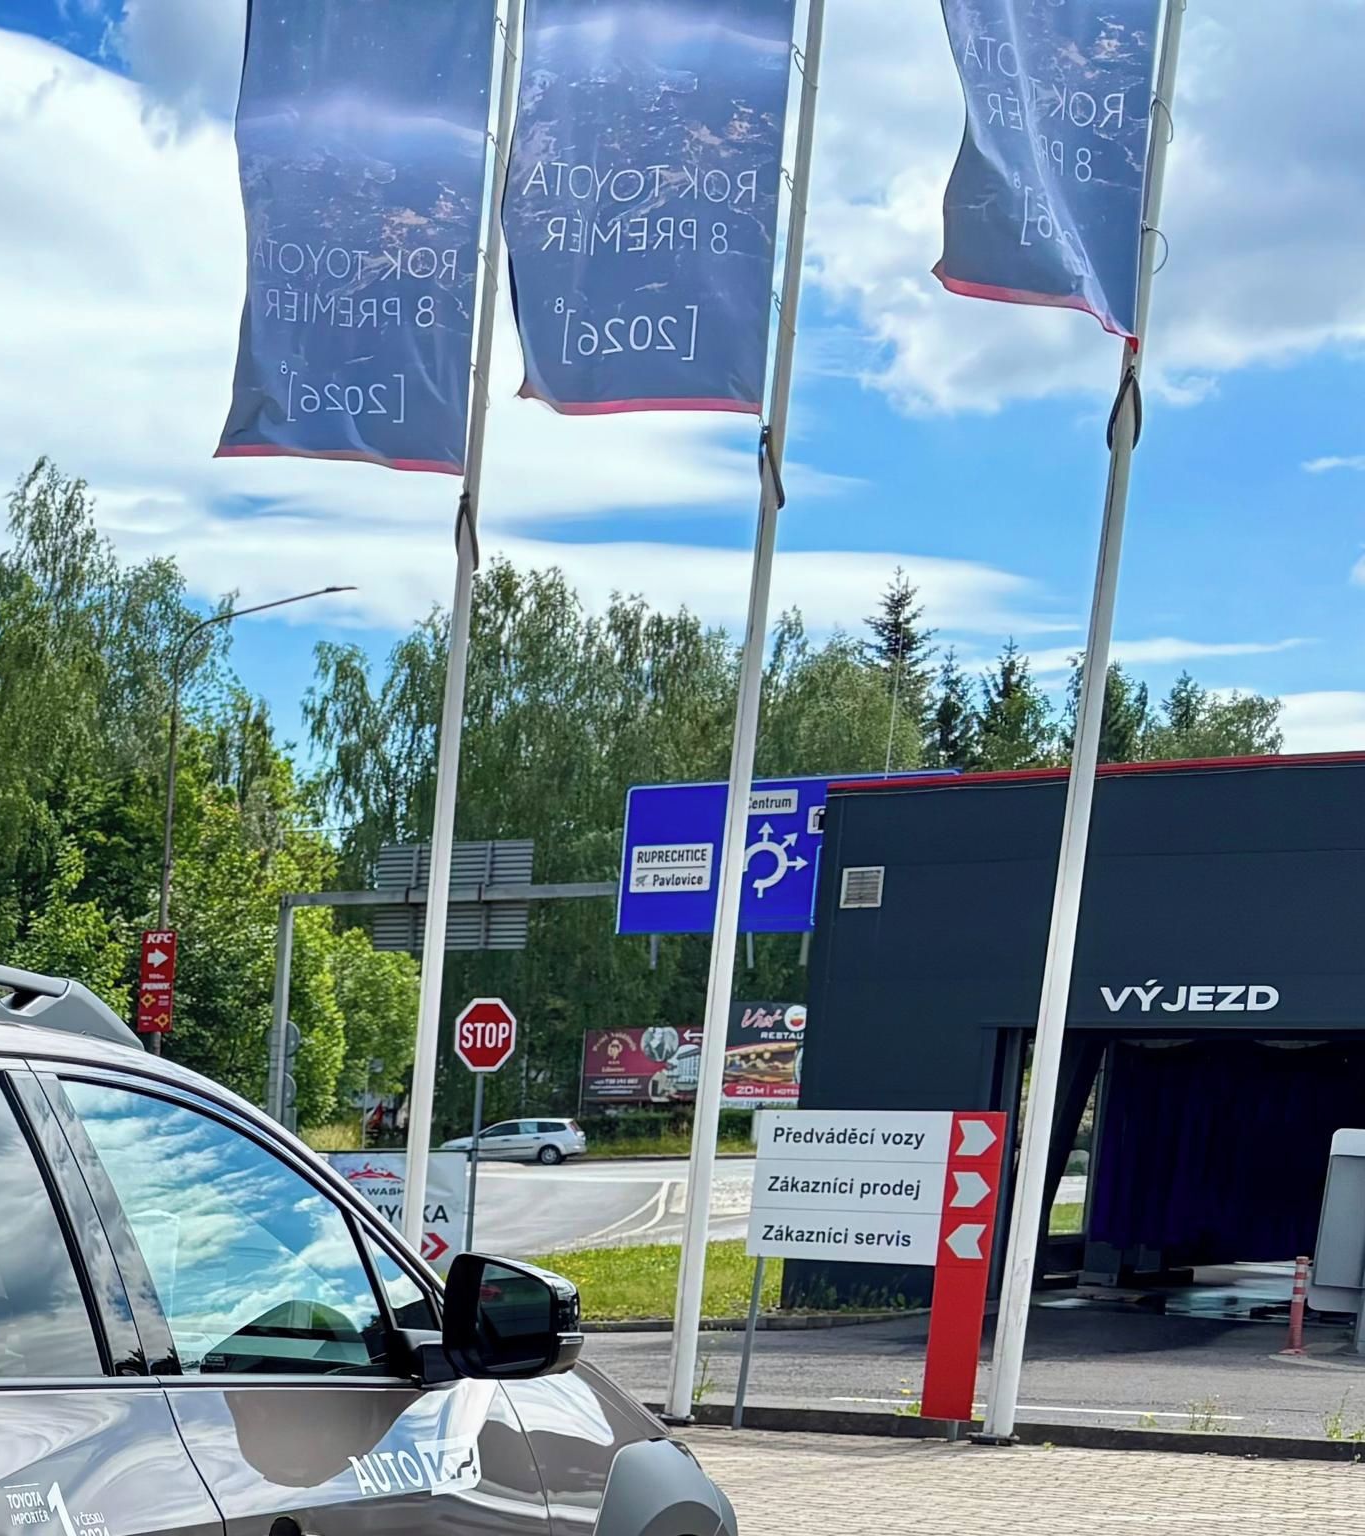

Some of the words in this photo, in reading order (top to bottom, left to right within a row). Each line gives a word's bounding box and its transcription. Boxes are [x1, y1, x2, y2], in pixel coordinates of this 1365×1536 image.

[636, 848, 709, 864] RUPRECHTICE
[652, 872, 704, 888] Pavlovice
[146, 932, 174, 944] KFC
[1099, 978, 1281, 1013] VÝJEZD
[460, 1011, 511, 1050] STOP
[772, 1126, 877, 1146] Předváděcí
[881, 1133, 926, 1150] vozy
[767, 1175, 855, 1196] Zákazníci
[859, 1178, 922, 1200] prodej
[761, 1224, 850, 1246] Zákazníci
[854, 1230, 913, 1248] servis
[347, 1449, 424, 1497] AUTO
[4, 1490, 45, 1510] TOYOTA
[10, 1509, 51, 1527] IMPORTÉR
